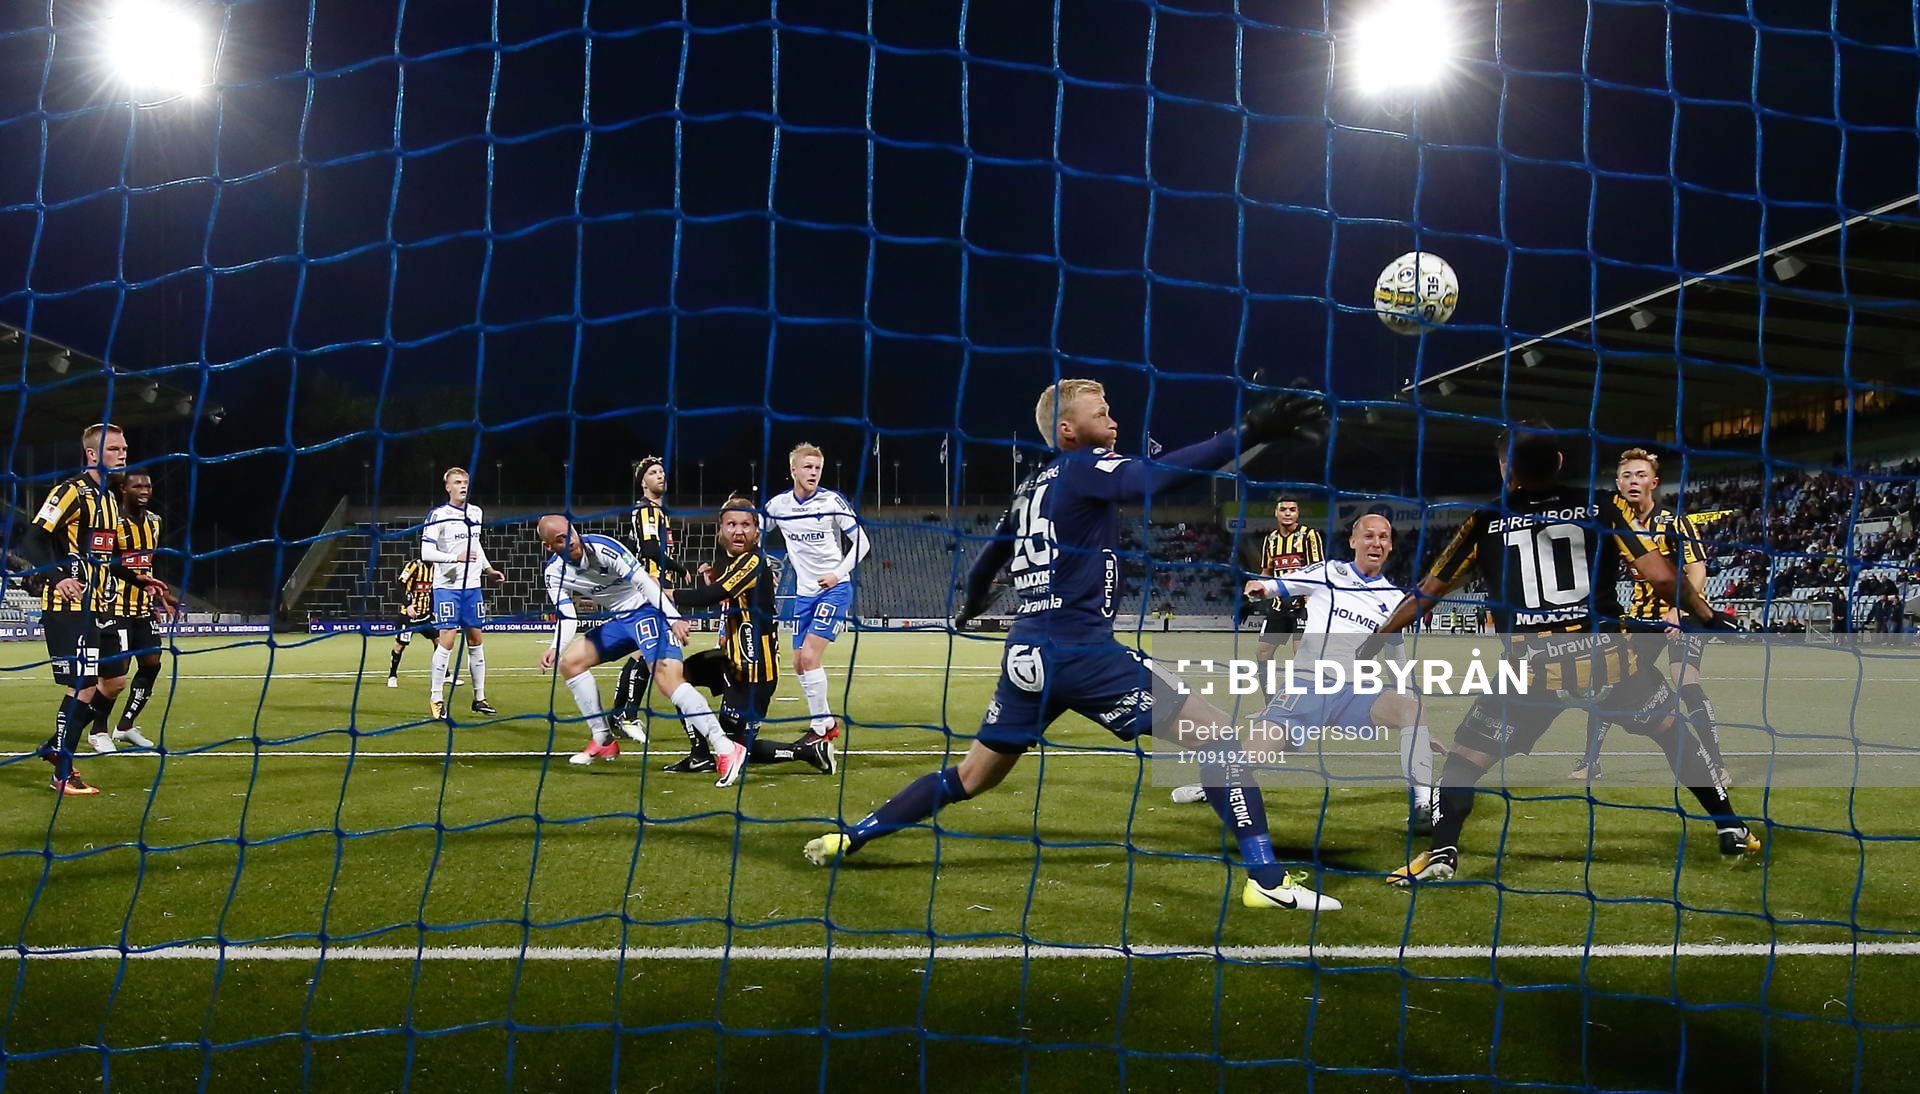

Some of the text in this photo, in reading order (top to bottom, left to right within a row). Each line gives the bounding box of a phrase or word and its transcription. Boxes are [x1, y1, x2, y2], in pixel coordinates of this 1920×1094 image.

[1011, 484, 1059, 572] 26
[1488, 504, 1600, 534] EHRENBORG
[1105, 560, 1114, 607] BOHUS
[1503, 523, 1591, 608] 10
[1516, 604, 1589, 626] MAXXIS
[1547, 632, 1611, 657] bravida
